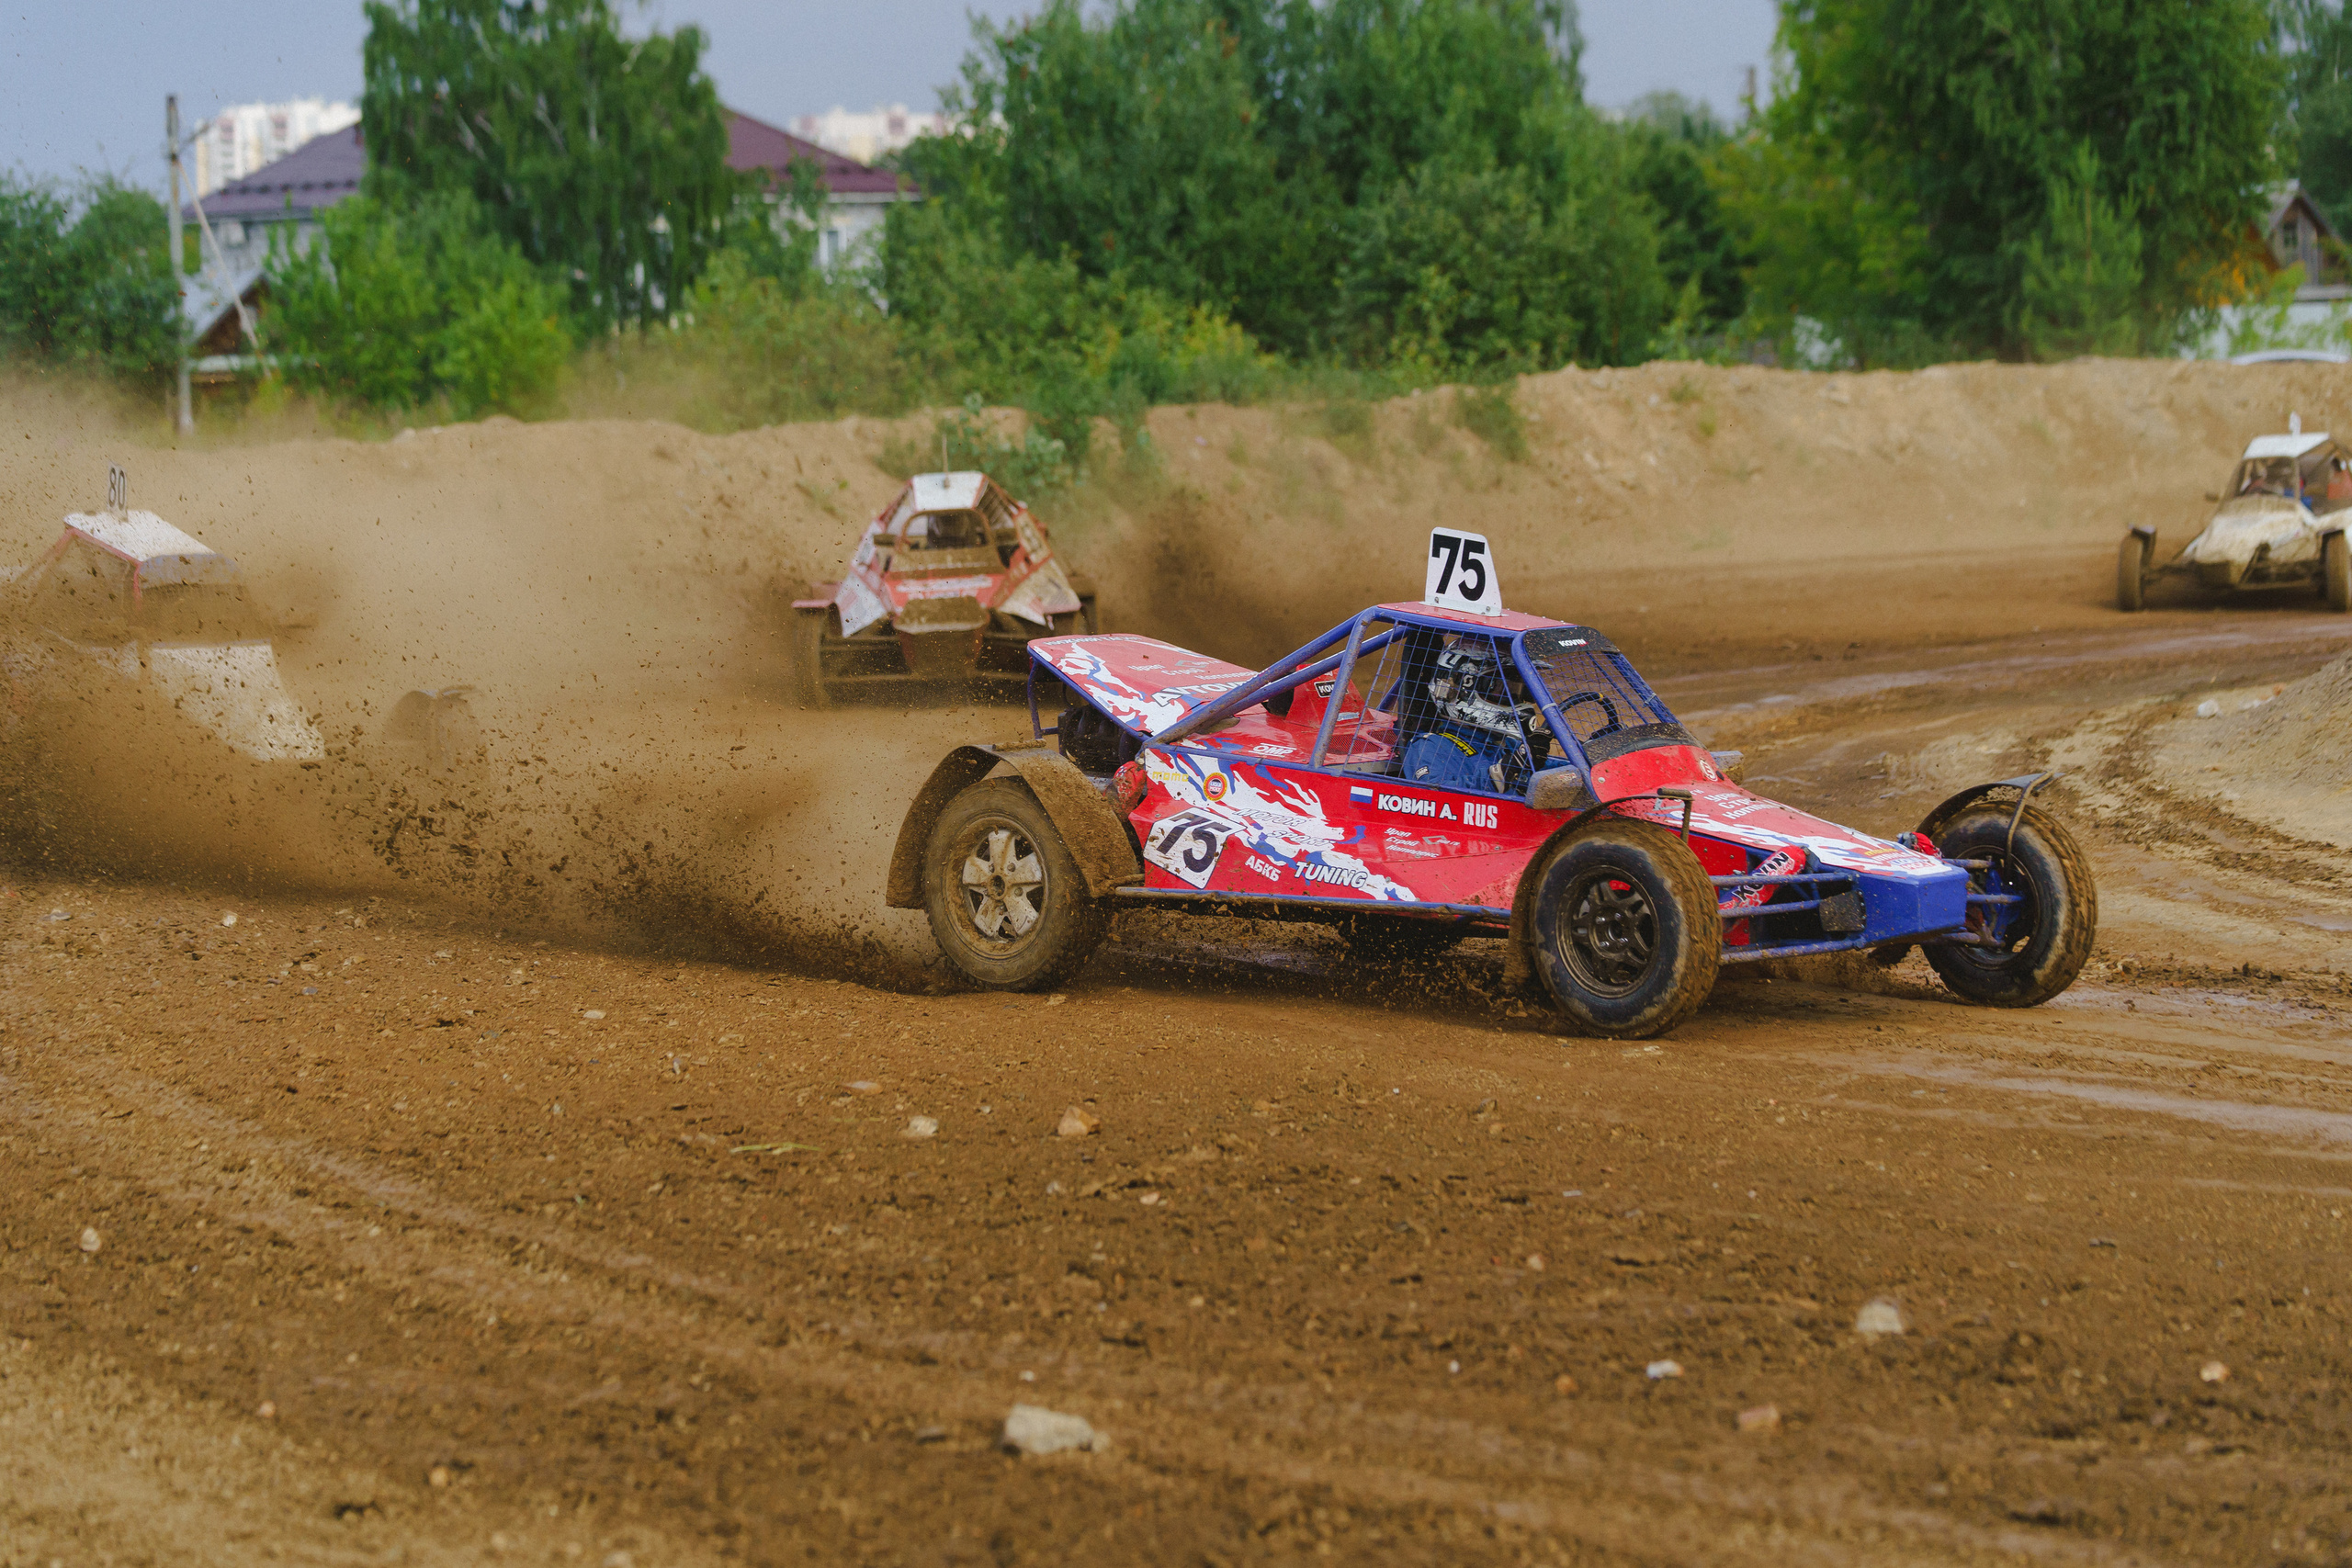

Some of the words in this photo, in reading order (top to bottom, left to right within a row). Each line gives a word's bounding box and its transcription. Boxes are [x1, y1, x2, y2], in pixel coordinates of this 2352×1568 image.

[108, 468, 125, 511] 80
[1431, 533, 1486, 602] 75
[1558, 638, 1587, 647] KOVIN
[1252, 743, 1295, 756] OMP
[1152, 771, 1190, 783] momo
[1232, 807, 1306, 827] MOTOR
[1377, 793, 1436, 818] КОВИН
[1439, 803, 1457, 821] А.
[1464, 801, 1498, 829] RUS
[1156, 811, 1233, 874] 75
[1267, 829, 1336, 847] SPORT
[1244, 854, 1282, 882] АБКБ
[1294, 860, 1369, 889] TUNING
